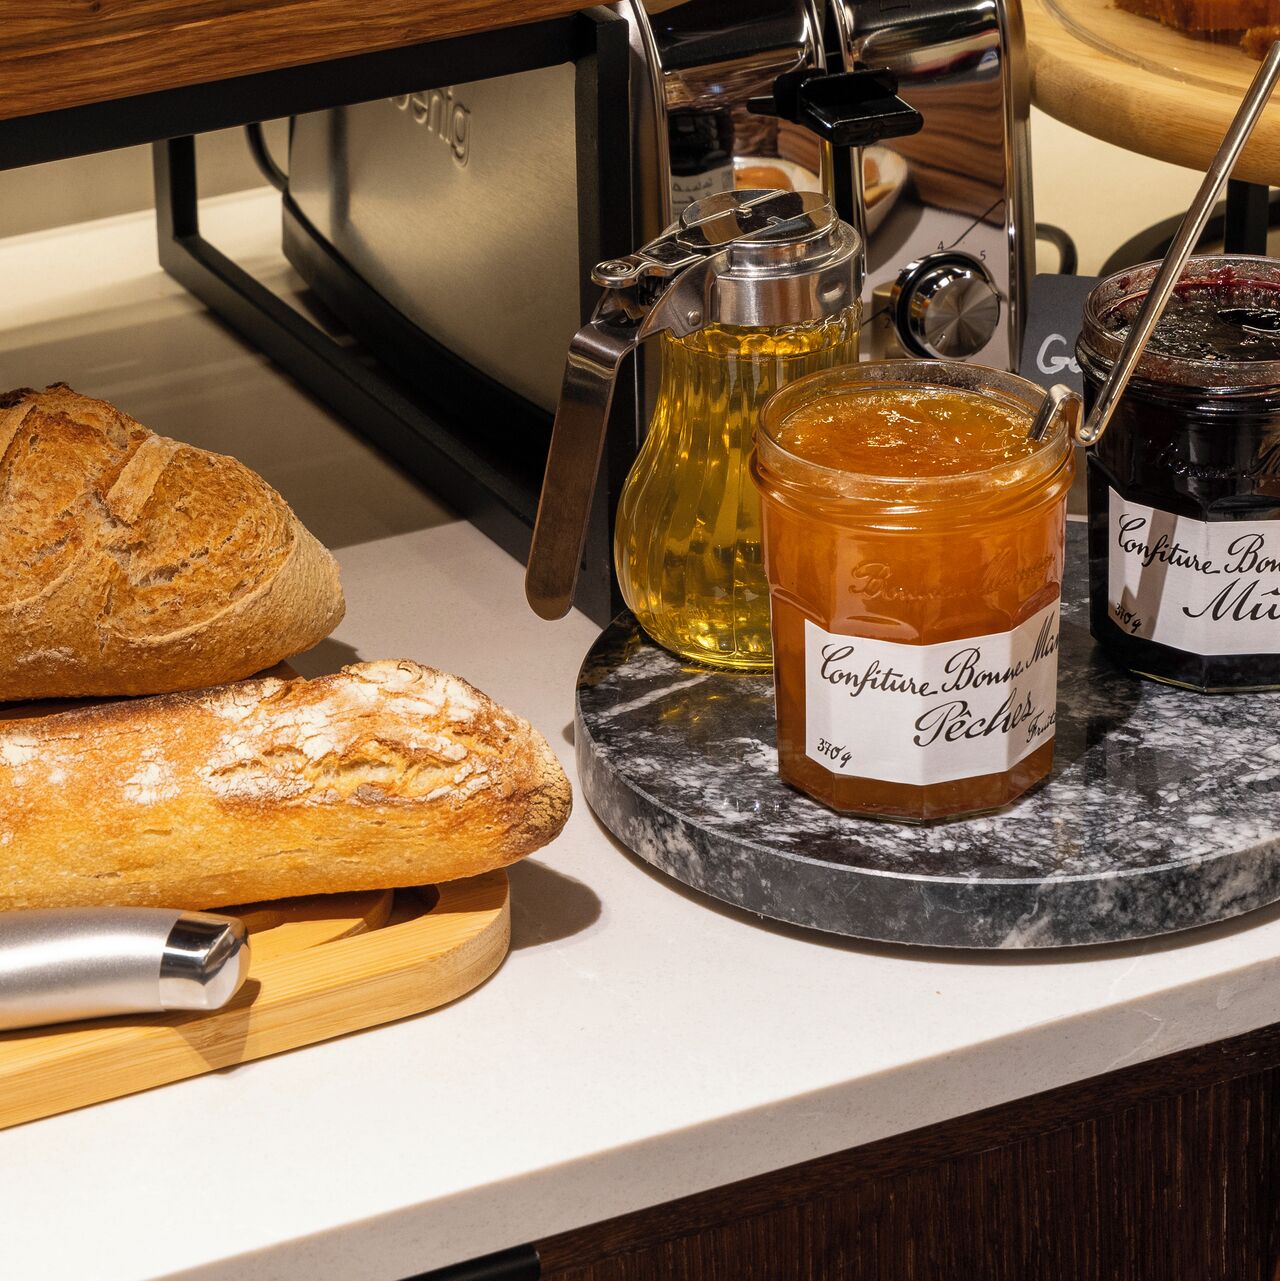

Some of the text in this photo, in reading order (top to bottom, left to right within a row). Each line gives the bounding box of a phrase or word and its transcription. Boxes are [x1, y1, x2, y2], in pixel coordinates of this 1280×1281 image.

[937, 240, 945, 251] 4
[979, 250, 986, 261] 5
[1118, 514, 1220, 575] Confiture
[821, 643, 938, 698] Confiture
[941, 646, 1024, 694] Bonne
[913, 688, 1038, 748] Pêches
